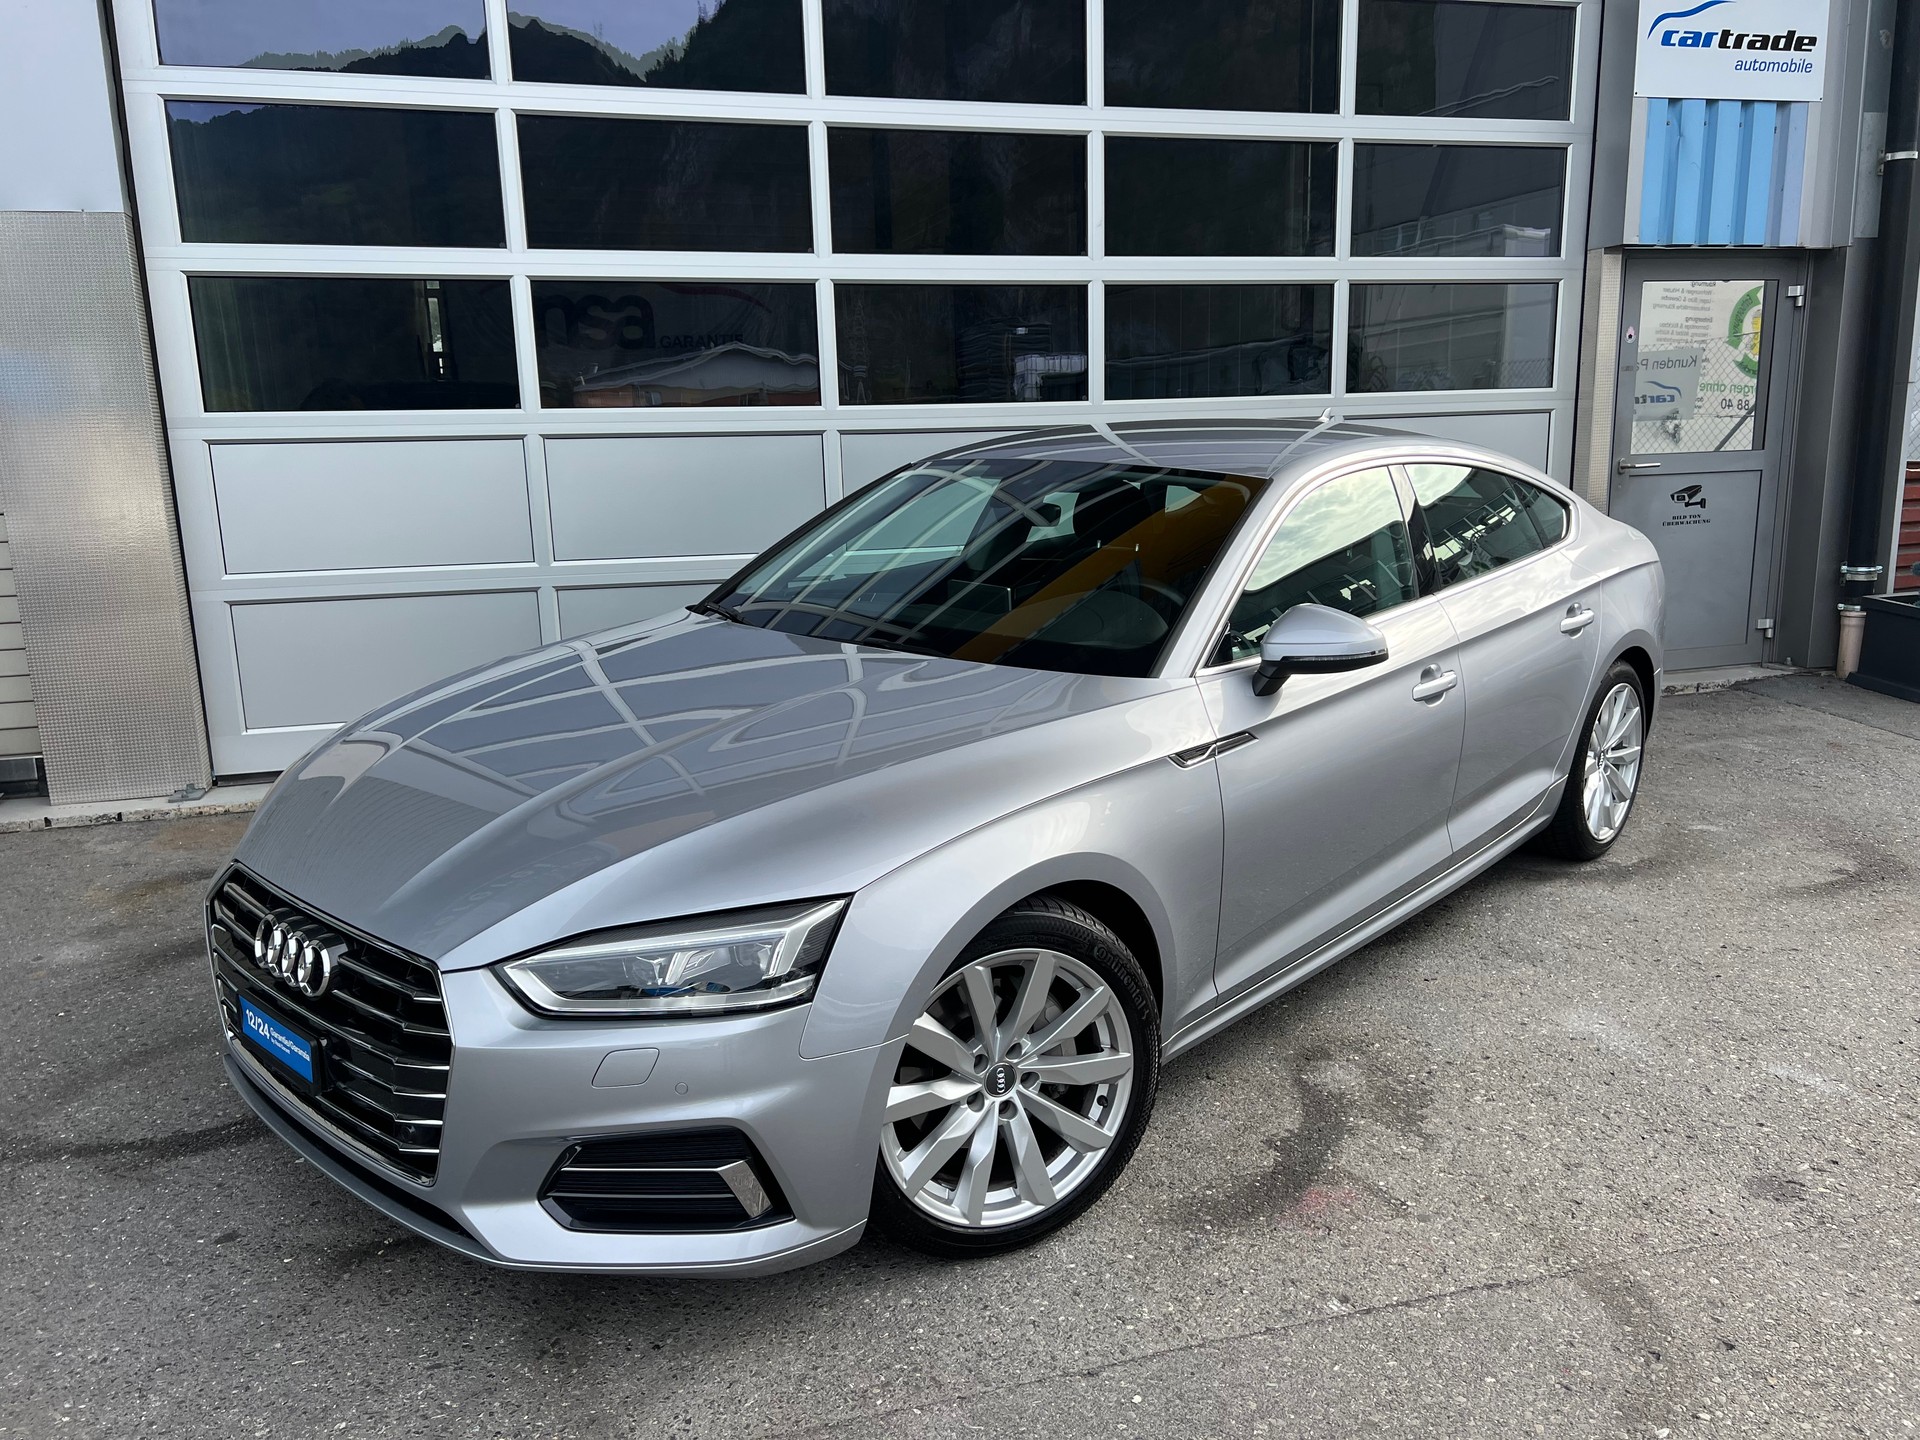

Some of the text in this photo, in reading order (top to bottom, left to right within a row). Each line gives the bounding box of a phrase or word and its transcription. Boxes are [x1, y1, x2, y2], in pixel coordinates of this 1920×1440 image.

[1660, 28, 1818, 53] cartrade
[1734, 58, 1813, 74] automobile
[1662, 519, 1711, 527] ÜBERWACHUNG
[1093, 945, 1147, 1010] Continental
[245, 1008, 271, 1040] 12/24
